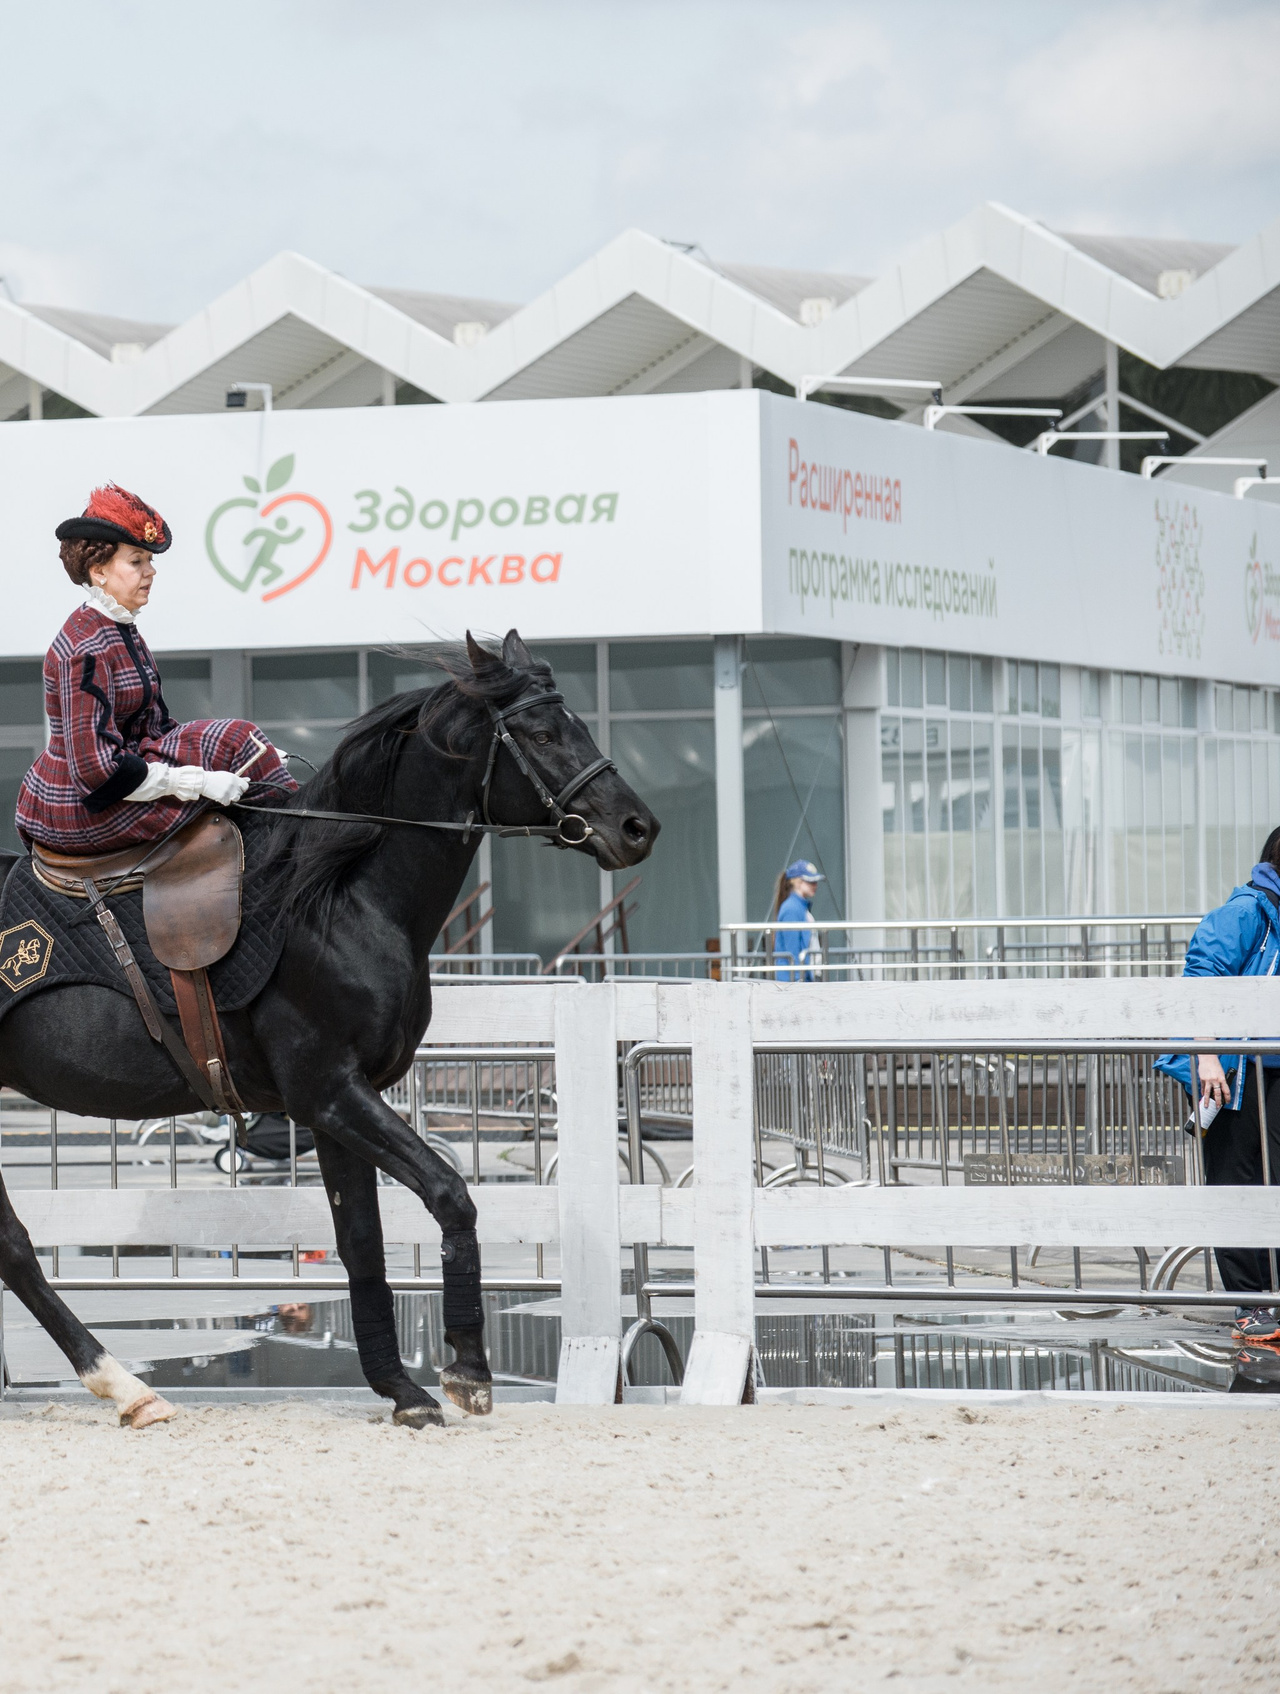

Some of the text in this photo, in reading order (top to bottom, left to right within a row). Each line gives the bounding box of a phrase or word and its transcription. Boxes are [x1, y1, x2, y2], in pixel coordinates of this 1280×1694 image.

[346, 485, 620, 542] Здоровая
[788, 438, 902, 534] Расширенная
[350, 547, 564, 590] Москва
[788, 547, 998, 622] программа исследований
